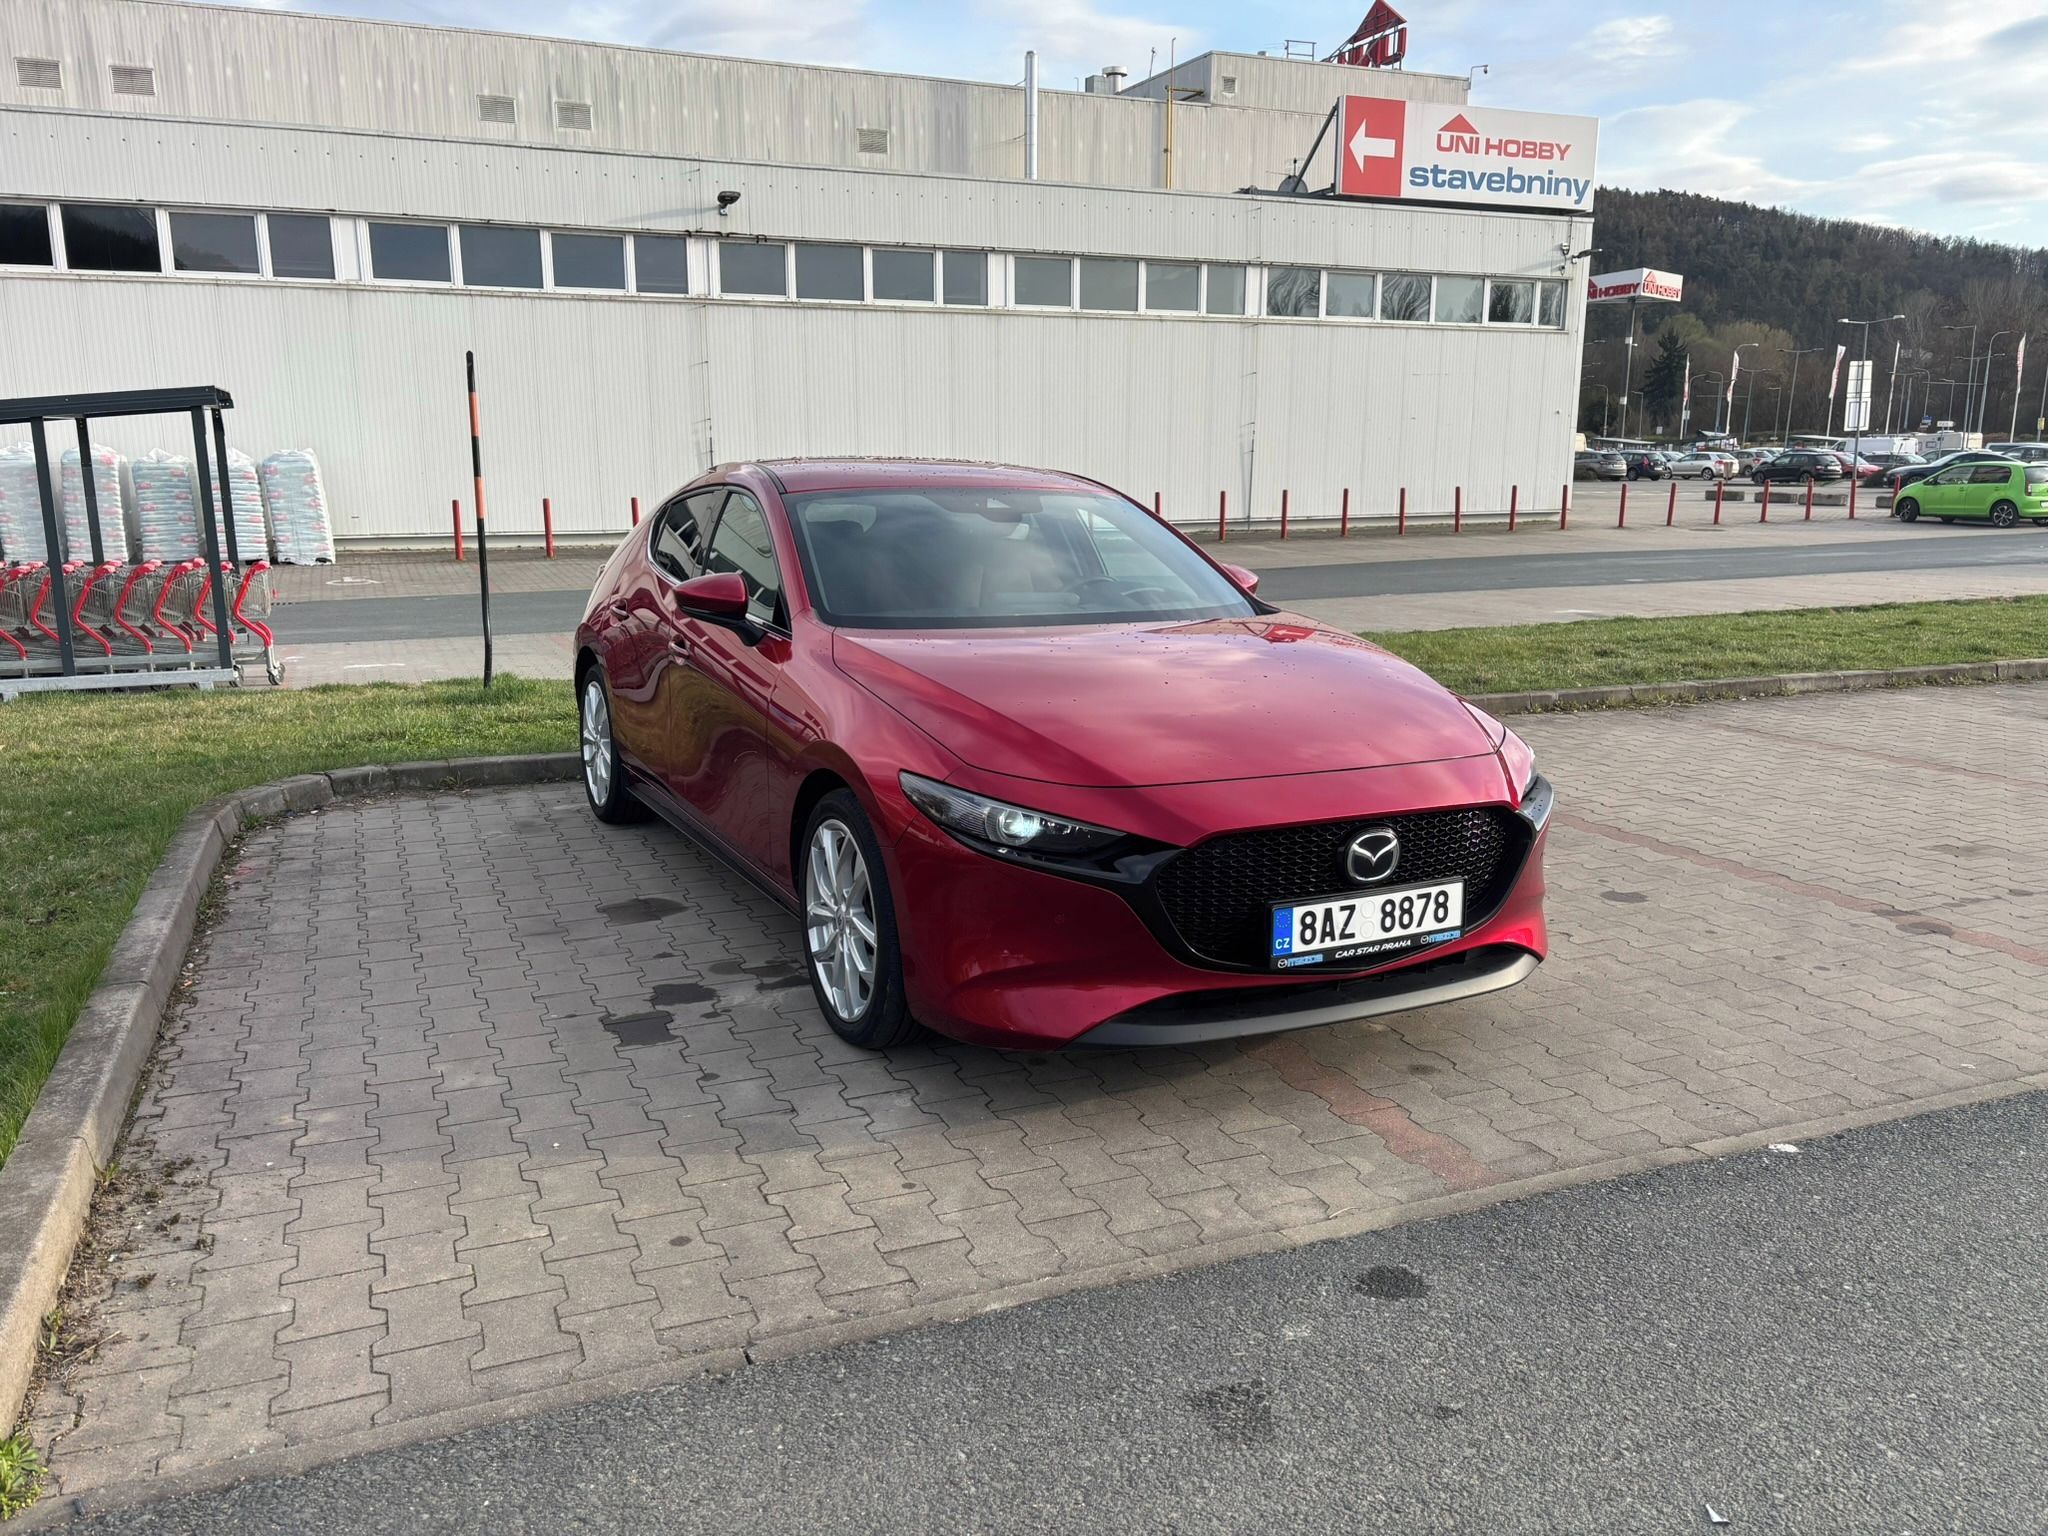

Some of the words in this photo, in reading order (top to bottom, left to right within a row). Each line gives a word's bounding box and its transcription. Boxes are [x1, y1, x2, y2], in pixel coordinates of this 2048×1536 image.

[1436, 132, 1480, 155] UNI
[1484, 137, 1572, 161] HOBBY
[1409, 164, 1590, 204] stavebniny
[1599, 283, 1640, 298] HOBBY
[1643, 281, 1658, 295] UNI
[1300, 903, 1356, 946] 8AZ
[1380, 890, 1449, 933] 8878
[1275, 937, 1290, 949] CZ
[1335, 950, 1354, 959] CAR
[1355, 946, 1379, 956] STAR
[1381, 939, 1411, 952] PRAHA
